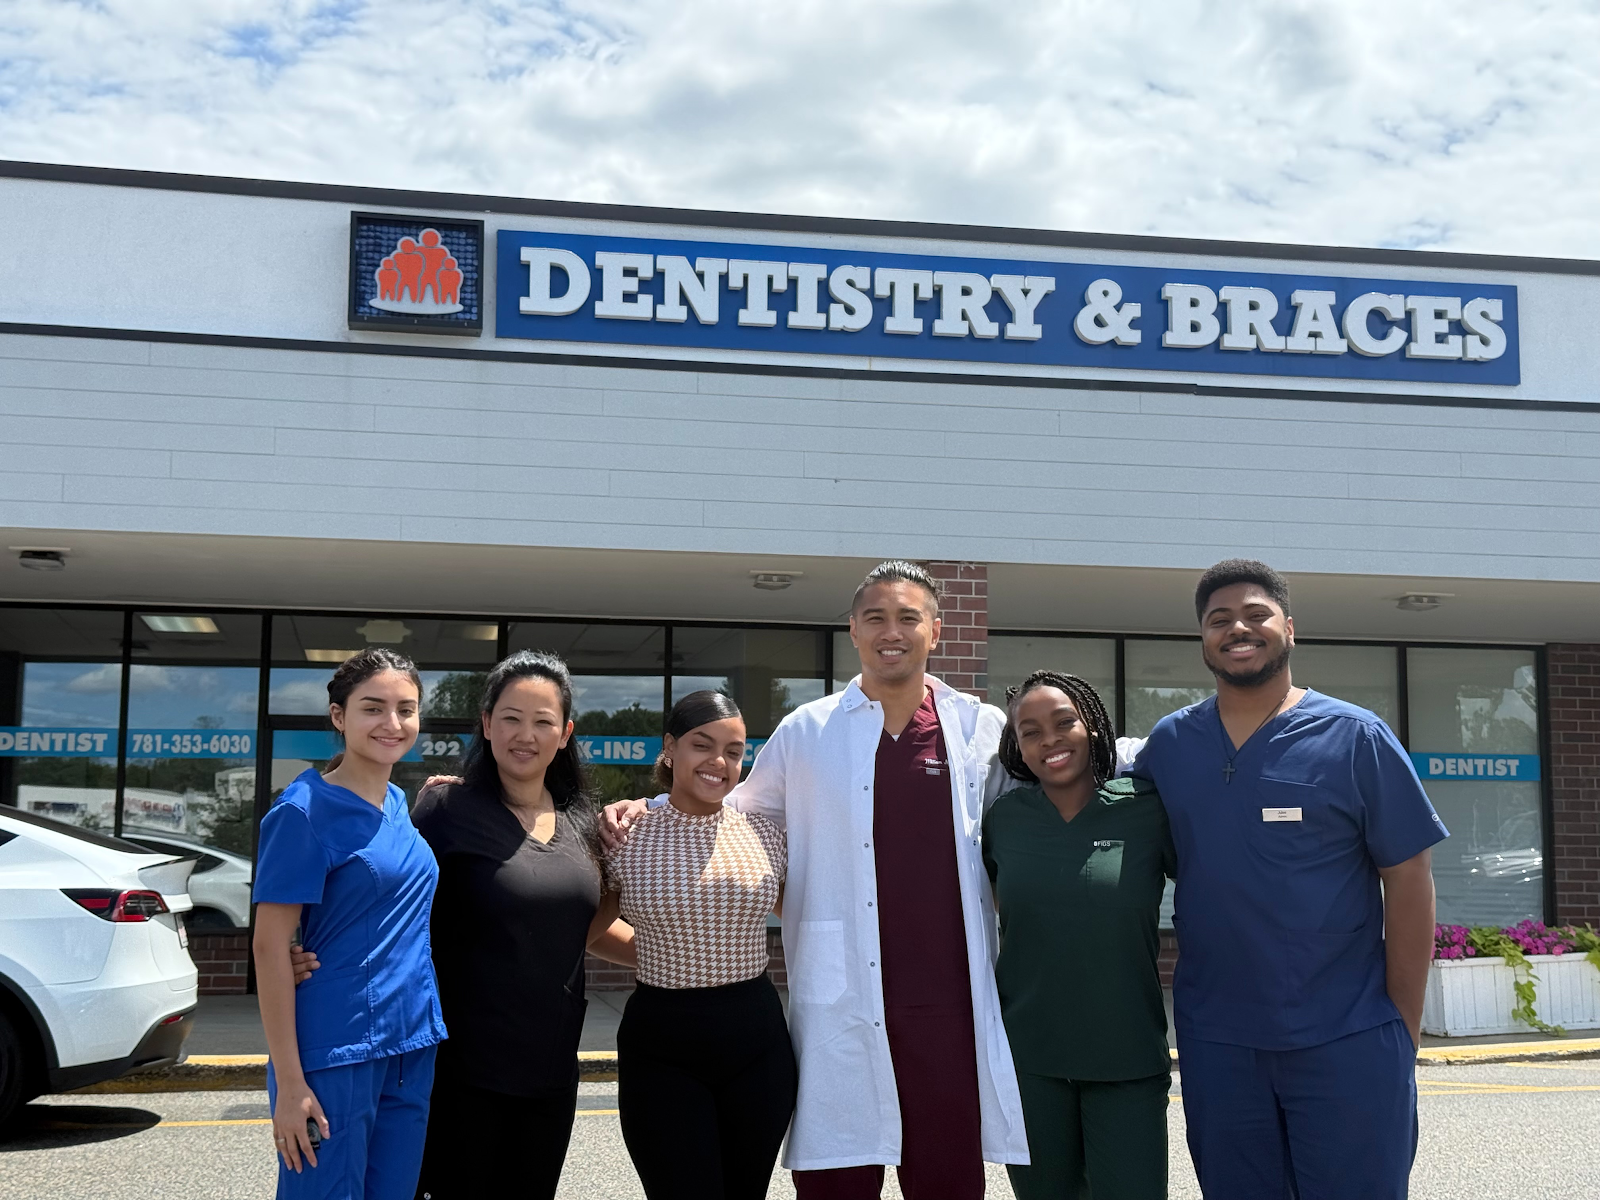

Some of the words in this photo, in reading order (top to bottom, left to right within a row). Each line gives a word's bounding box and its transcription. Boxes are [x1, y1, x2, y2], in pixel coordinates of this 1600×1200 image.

[519, 246, 1056, 341] DENTISTRY
[1073, 278, 1142, 346] &
[1161, 283, 1508, 362] BRACES
[0, 732, 108, 752] DENTIST
[132, 734, 251, 754] 781-353-6030
[421, 740, 461, 756] 292
[1429, 758, 1520, 776] DENTIST
